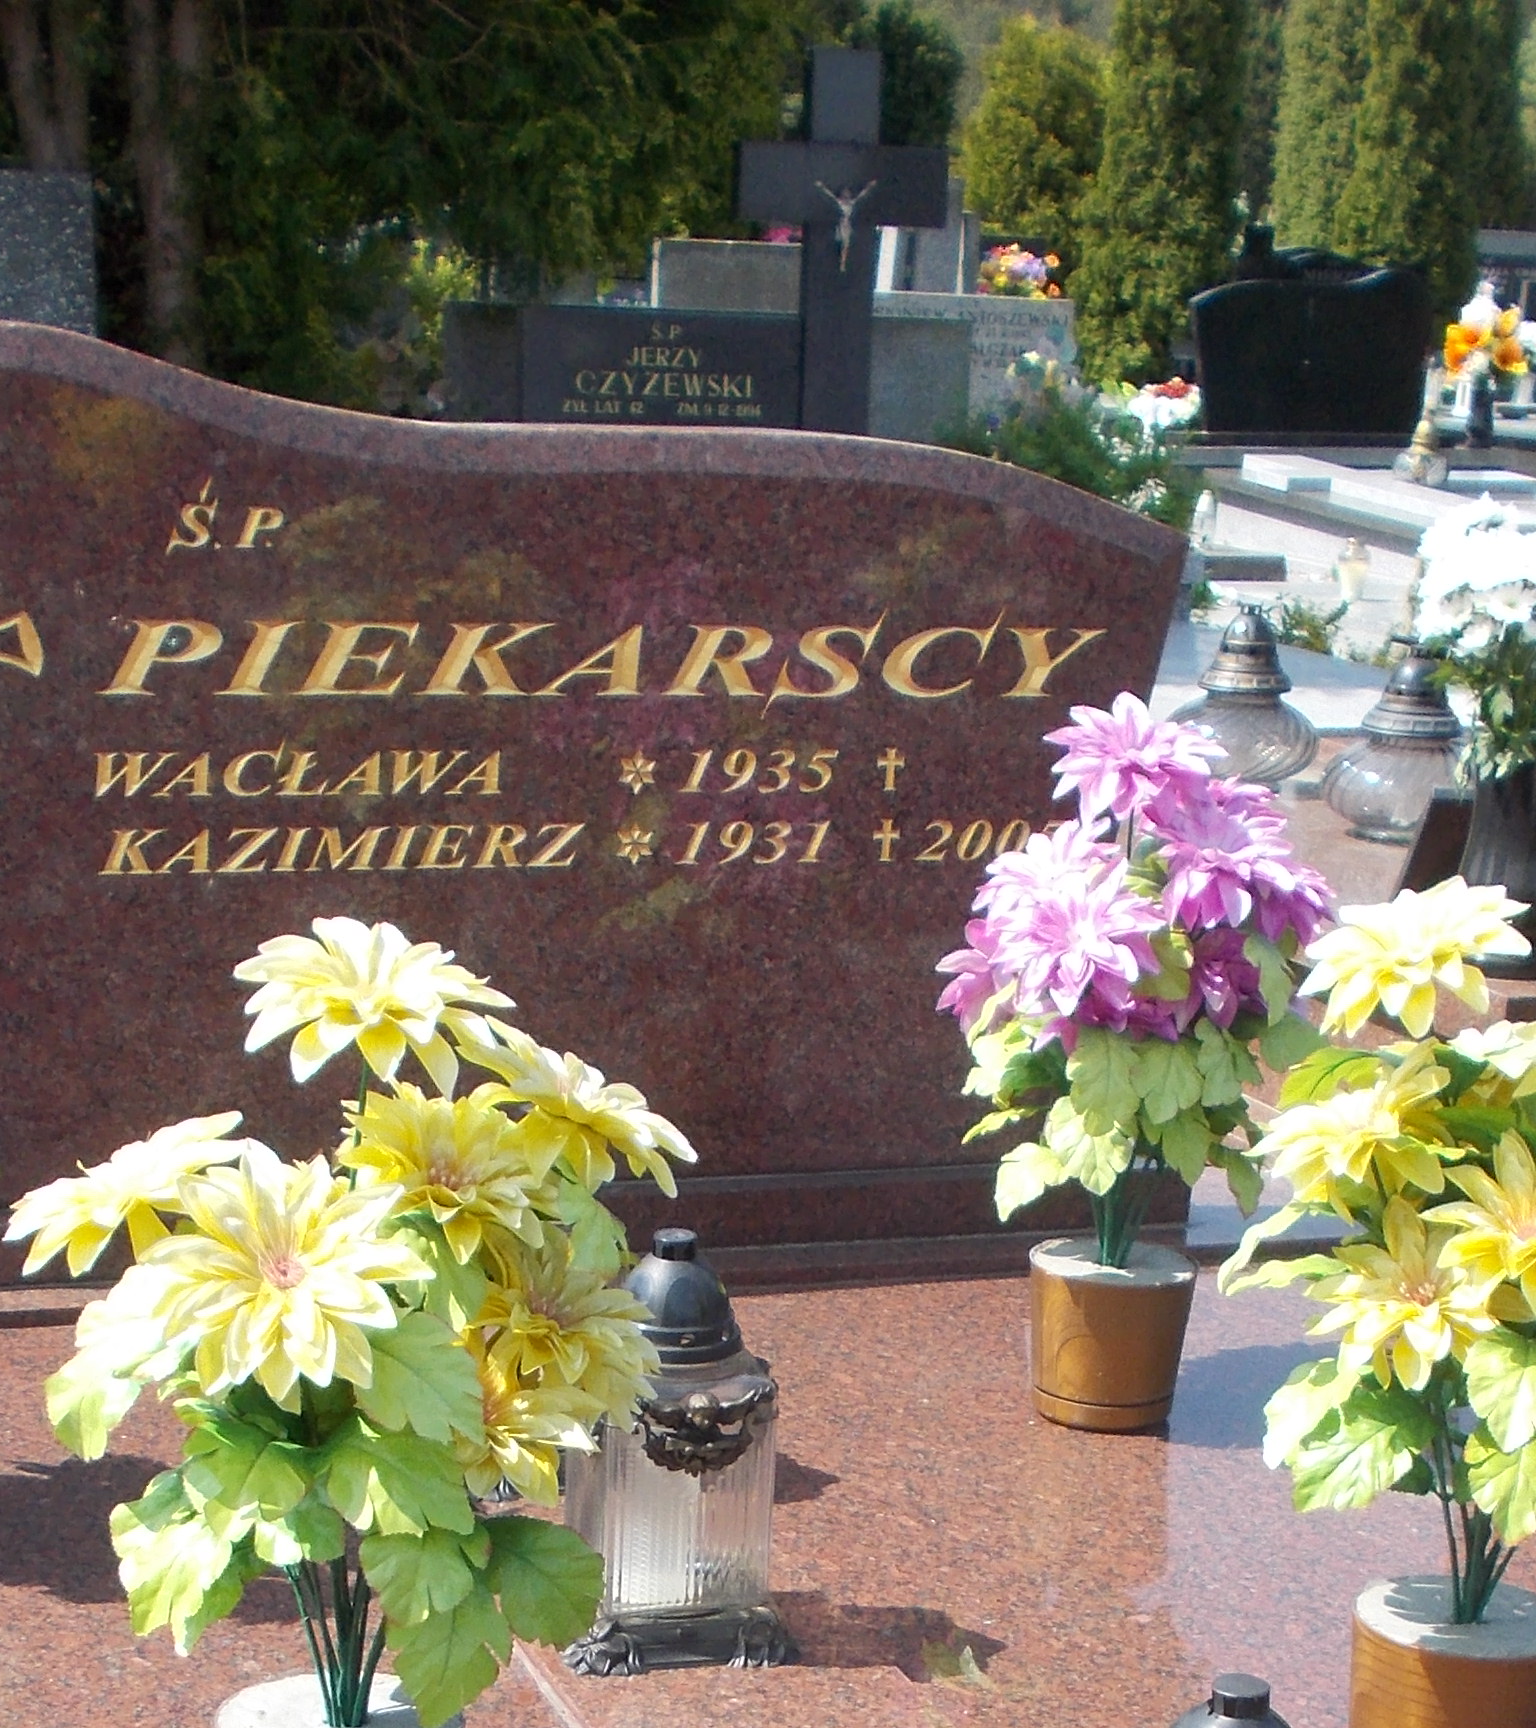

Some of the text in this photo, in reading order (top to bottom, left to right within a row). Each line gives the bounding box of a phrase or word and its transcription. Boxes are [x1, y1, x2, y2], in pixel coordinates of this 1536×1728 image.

[625, 345, 703, 369] JERZY
[95, 608, 1107, 719] PIEKARSCY
[93, 740, 839, 799] WACŁAWA 1935
[97, 818, 1067, 877] KAZIMIERZ 1931 200
